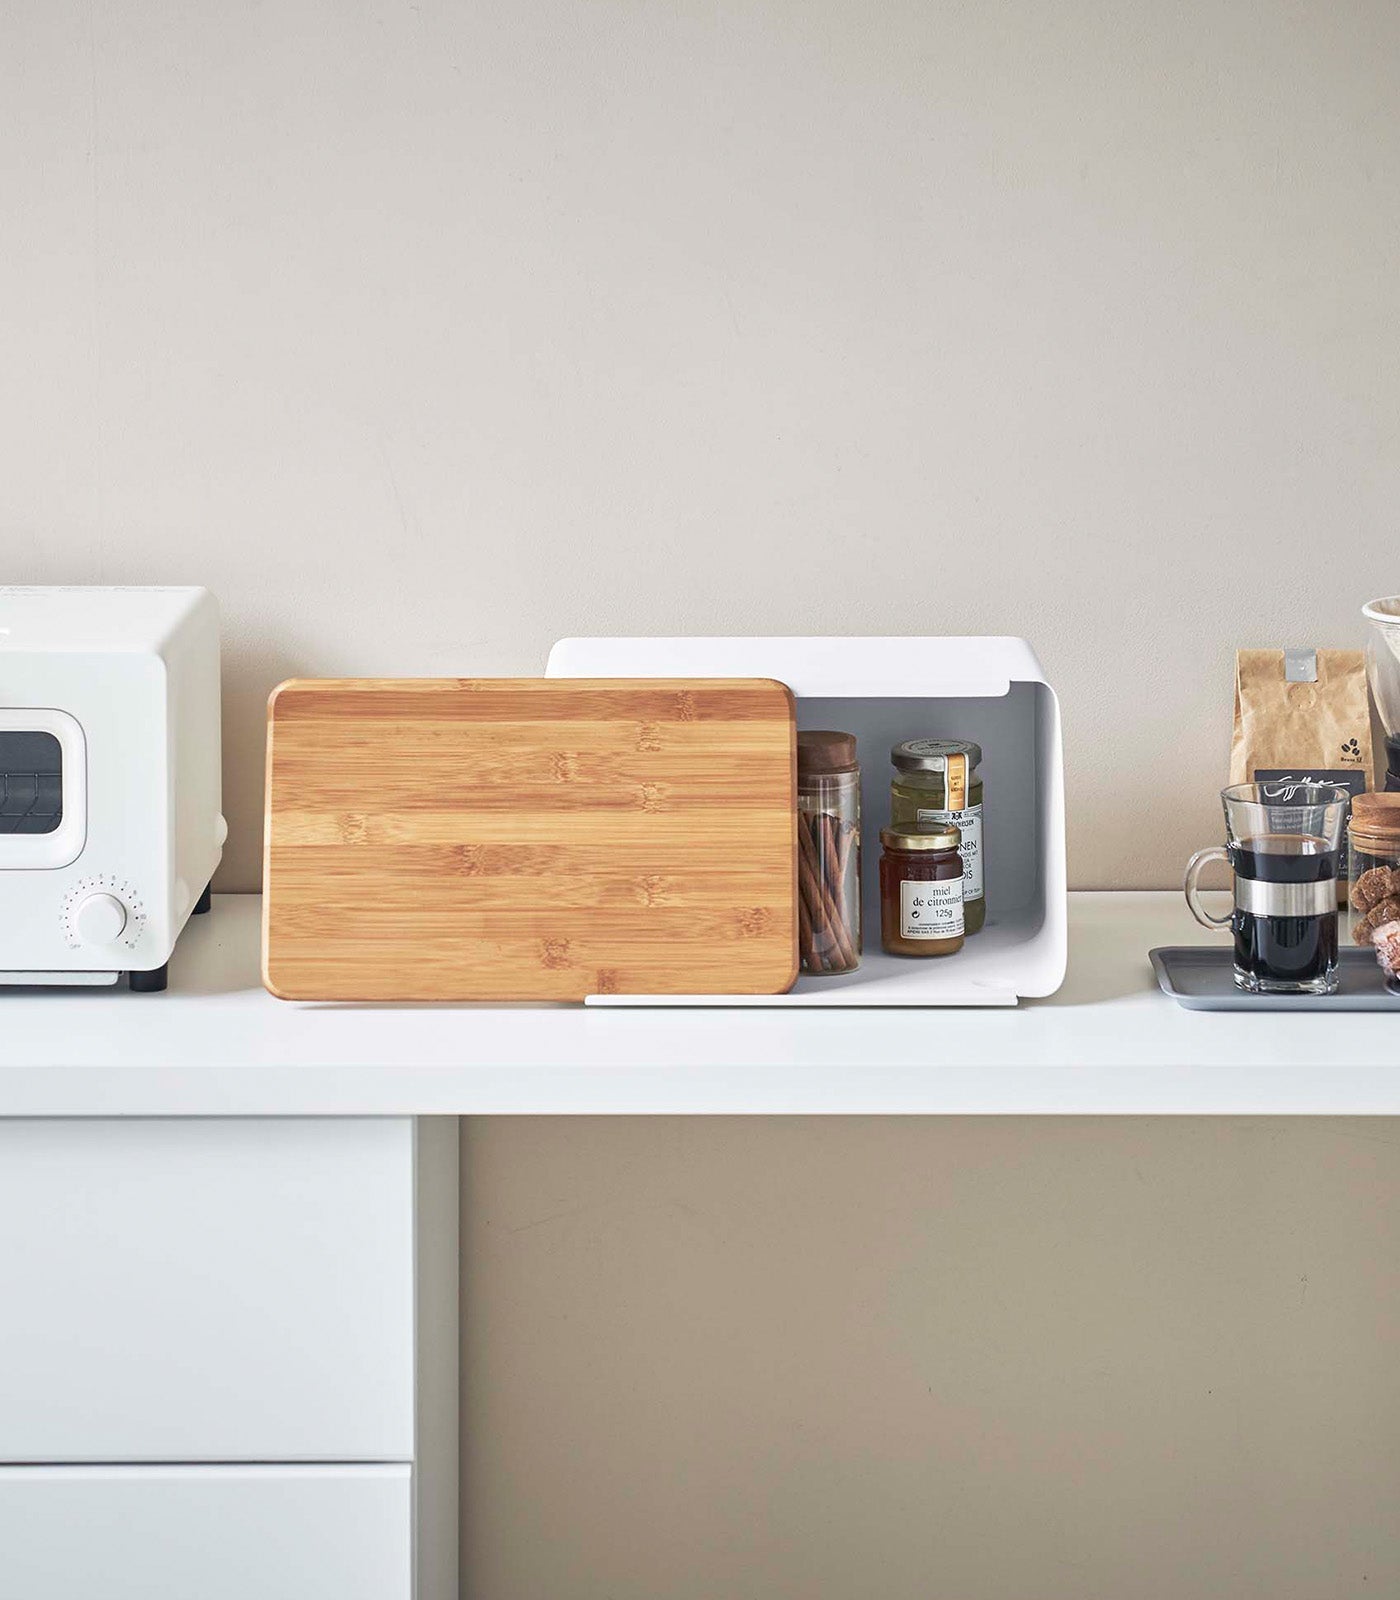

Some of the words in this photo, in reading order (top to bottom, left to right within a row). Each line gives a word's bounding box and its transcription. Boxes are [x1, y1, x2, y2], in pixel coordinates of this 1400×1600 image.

[960, 840, 977, 851] NEN
[932, 886, 951, 896] miel
[913, 897, 924, 907] de
[935, 909, 953, 918] 125g
